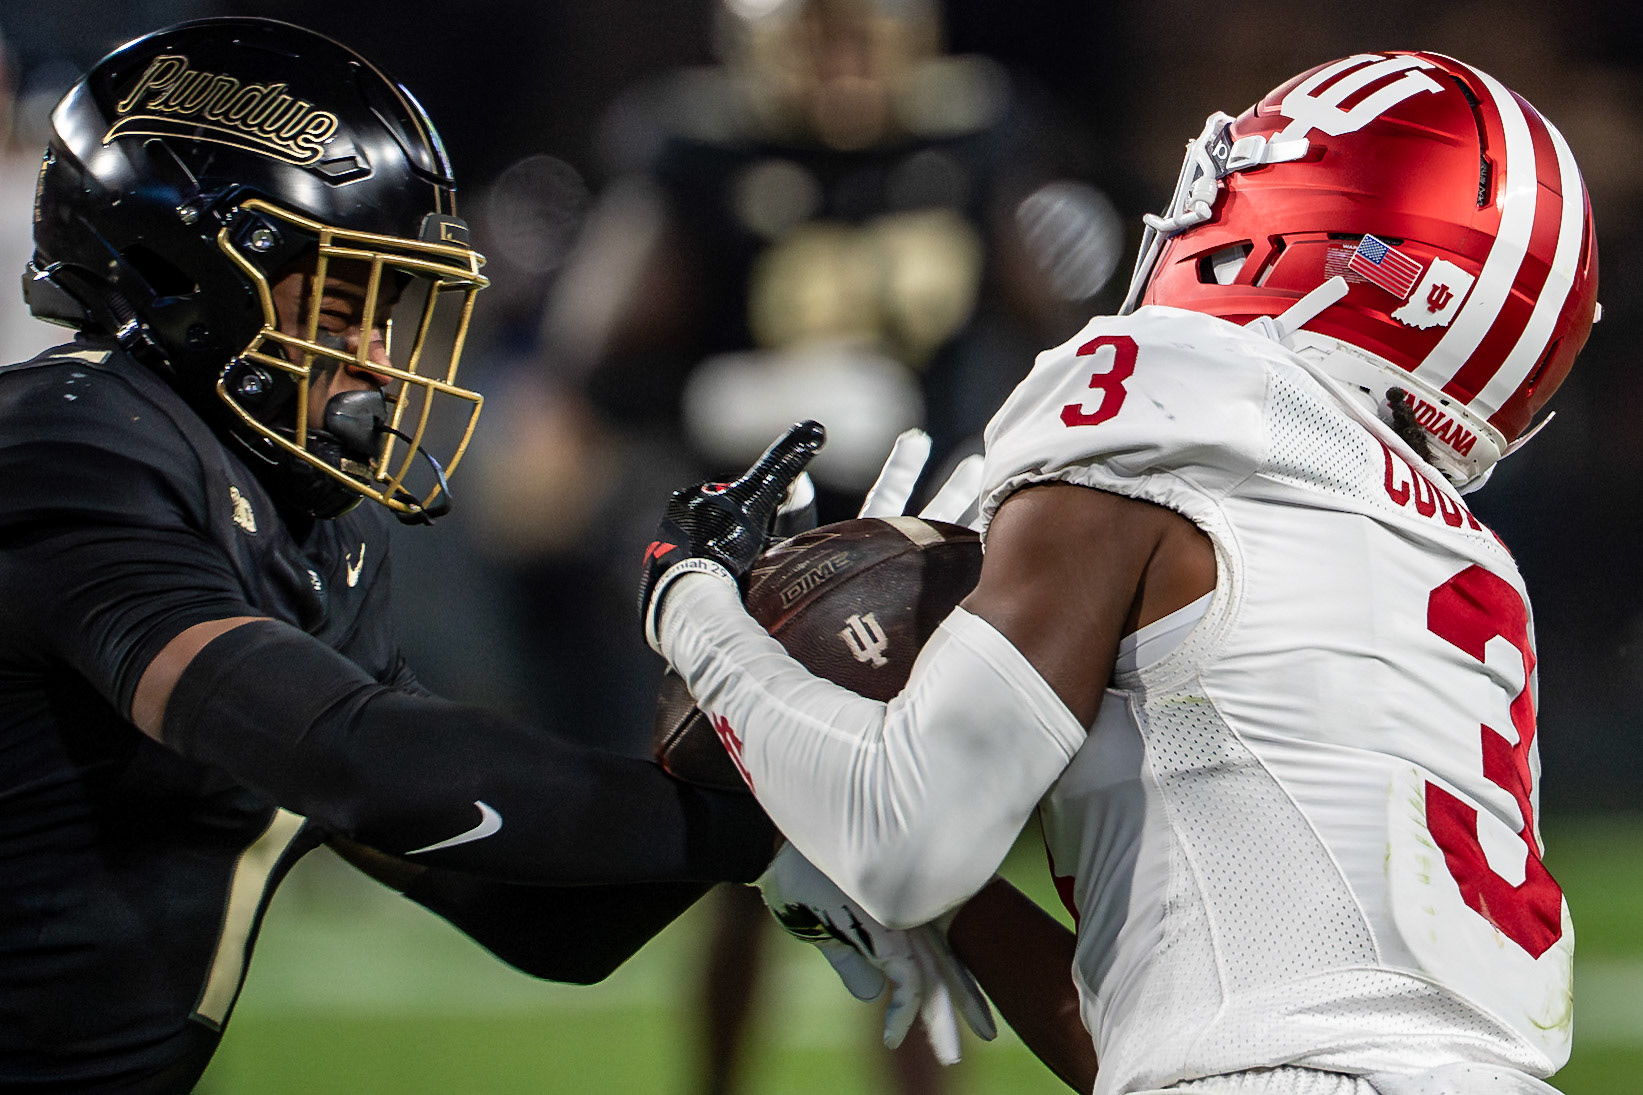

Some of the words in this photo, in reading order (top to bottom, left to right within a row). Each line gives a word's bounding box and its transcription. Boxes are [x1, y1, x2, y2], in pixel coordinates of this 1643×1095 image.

[110, 54, 339, 164] Purdue
[1060, 335, 1139, 428] 3
[1387, 388, 1478, 457] NDIANA
[1425, 564, 1563, 960] 3
